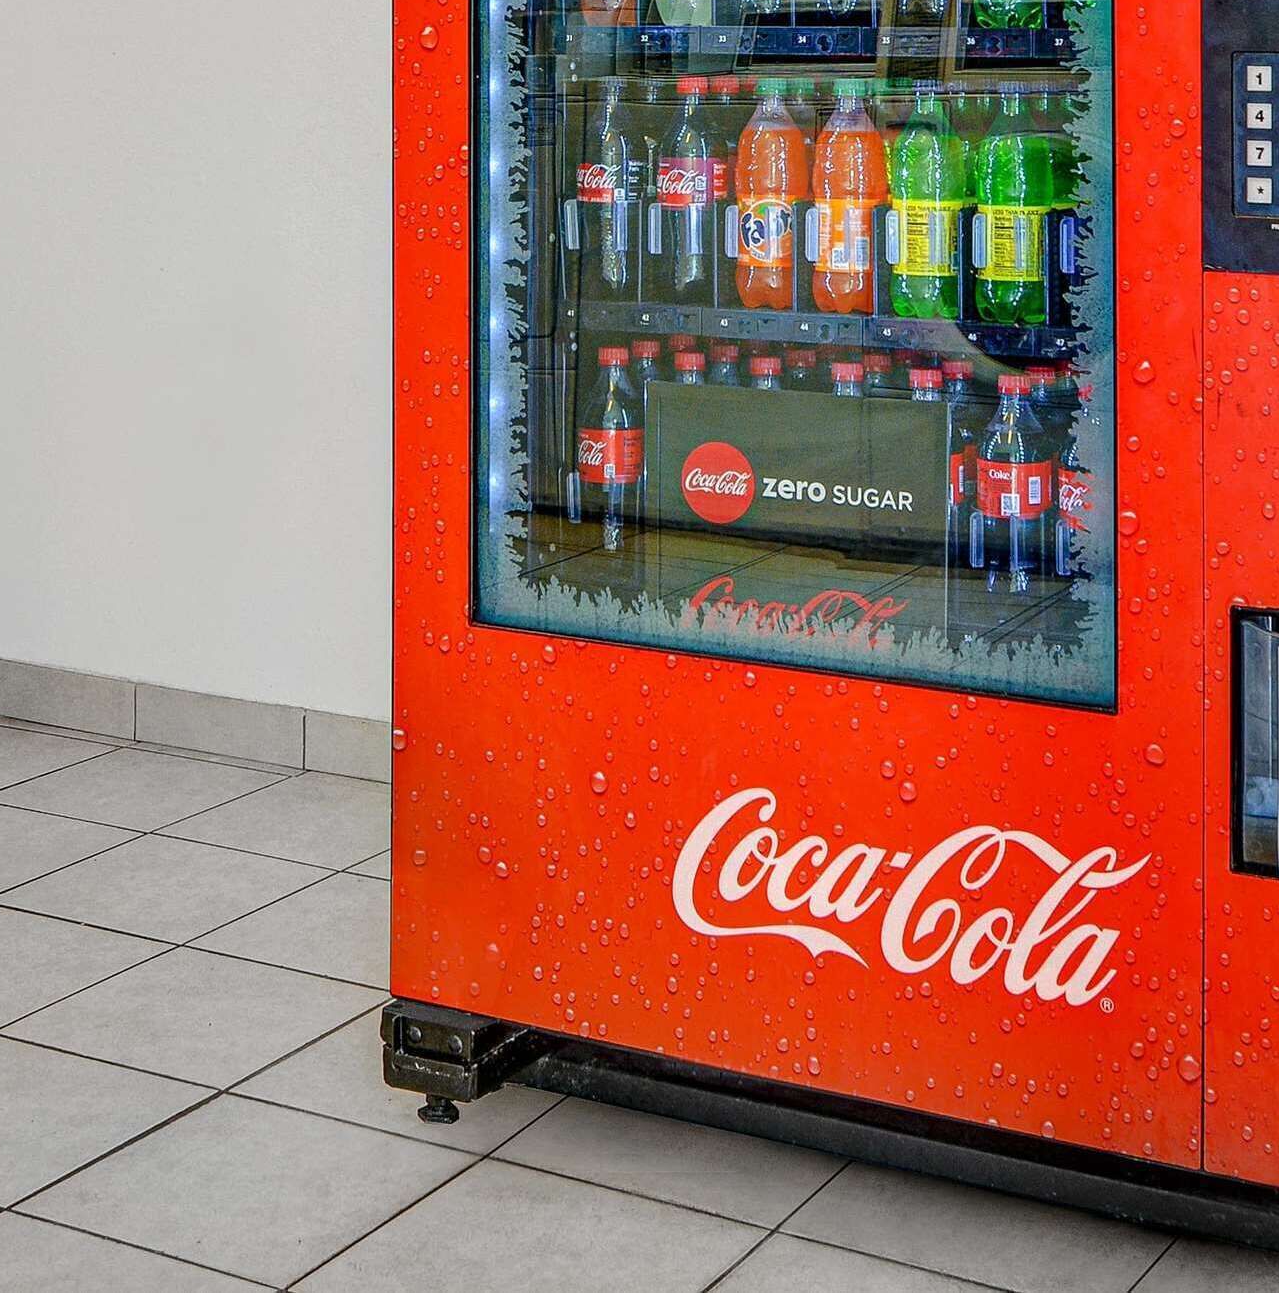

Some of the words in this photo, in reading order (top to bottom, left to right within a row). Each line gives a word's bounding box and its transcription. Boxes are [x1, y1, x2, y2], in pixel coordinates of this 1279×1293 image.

[1256, 73, 1263, 85] 1
[1255, 110, 1264, 122] 4
[1255, 147, 1265, 160] 7
[684, 467, 752, 497] Coca-Cola
[762, 477, 826, 503] zero
[832, 487, 913, 511] SUGAR
[672, 787, 1152, 1008] Coca-Cola
